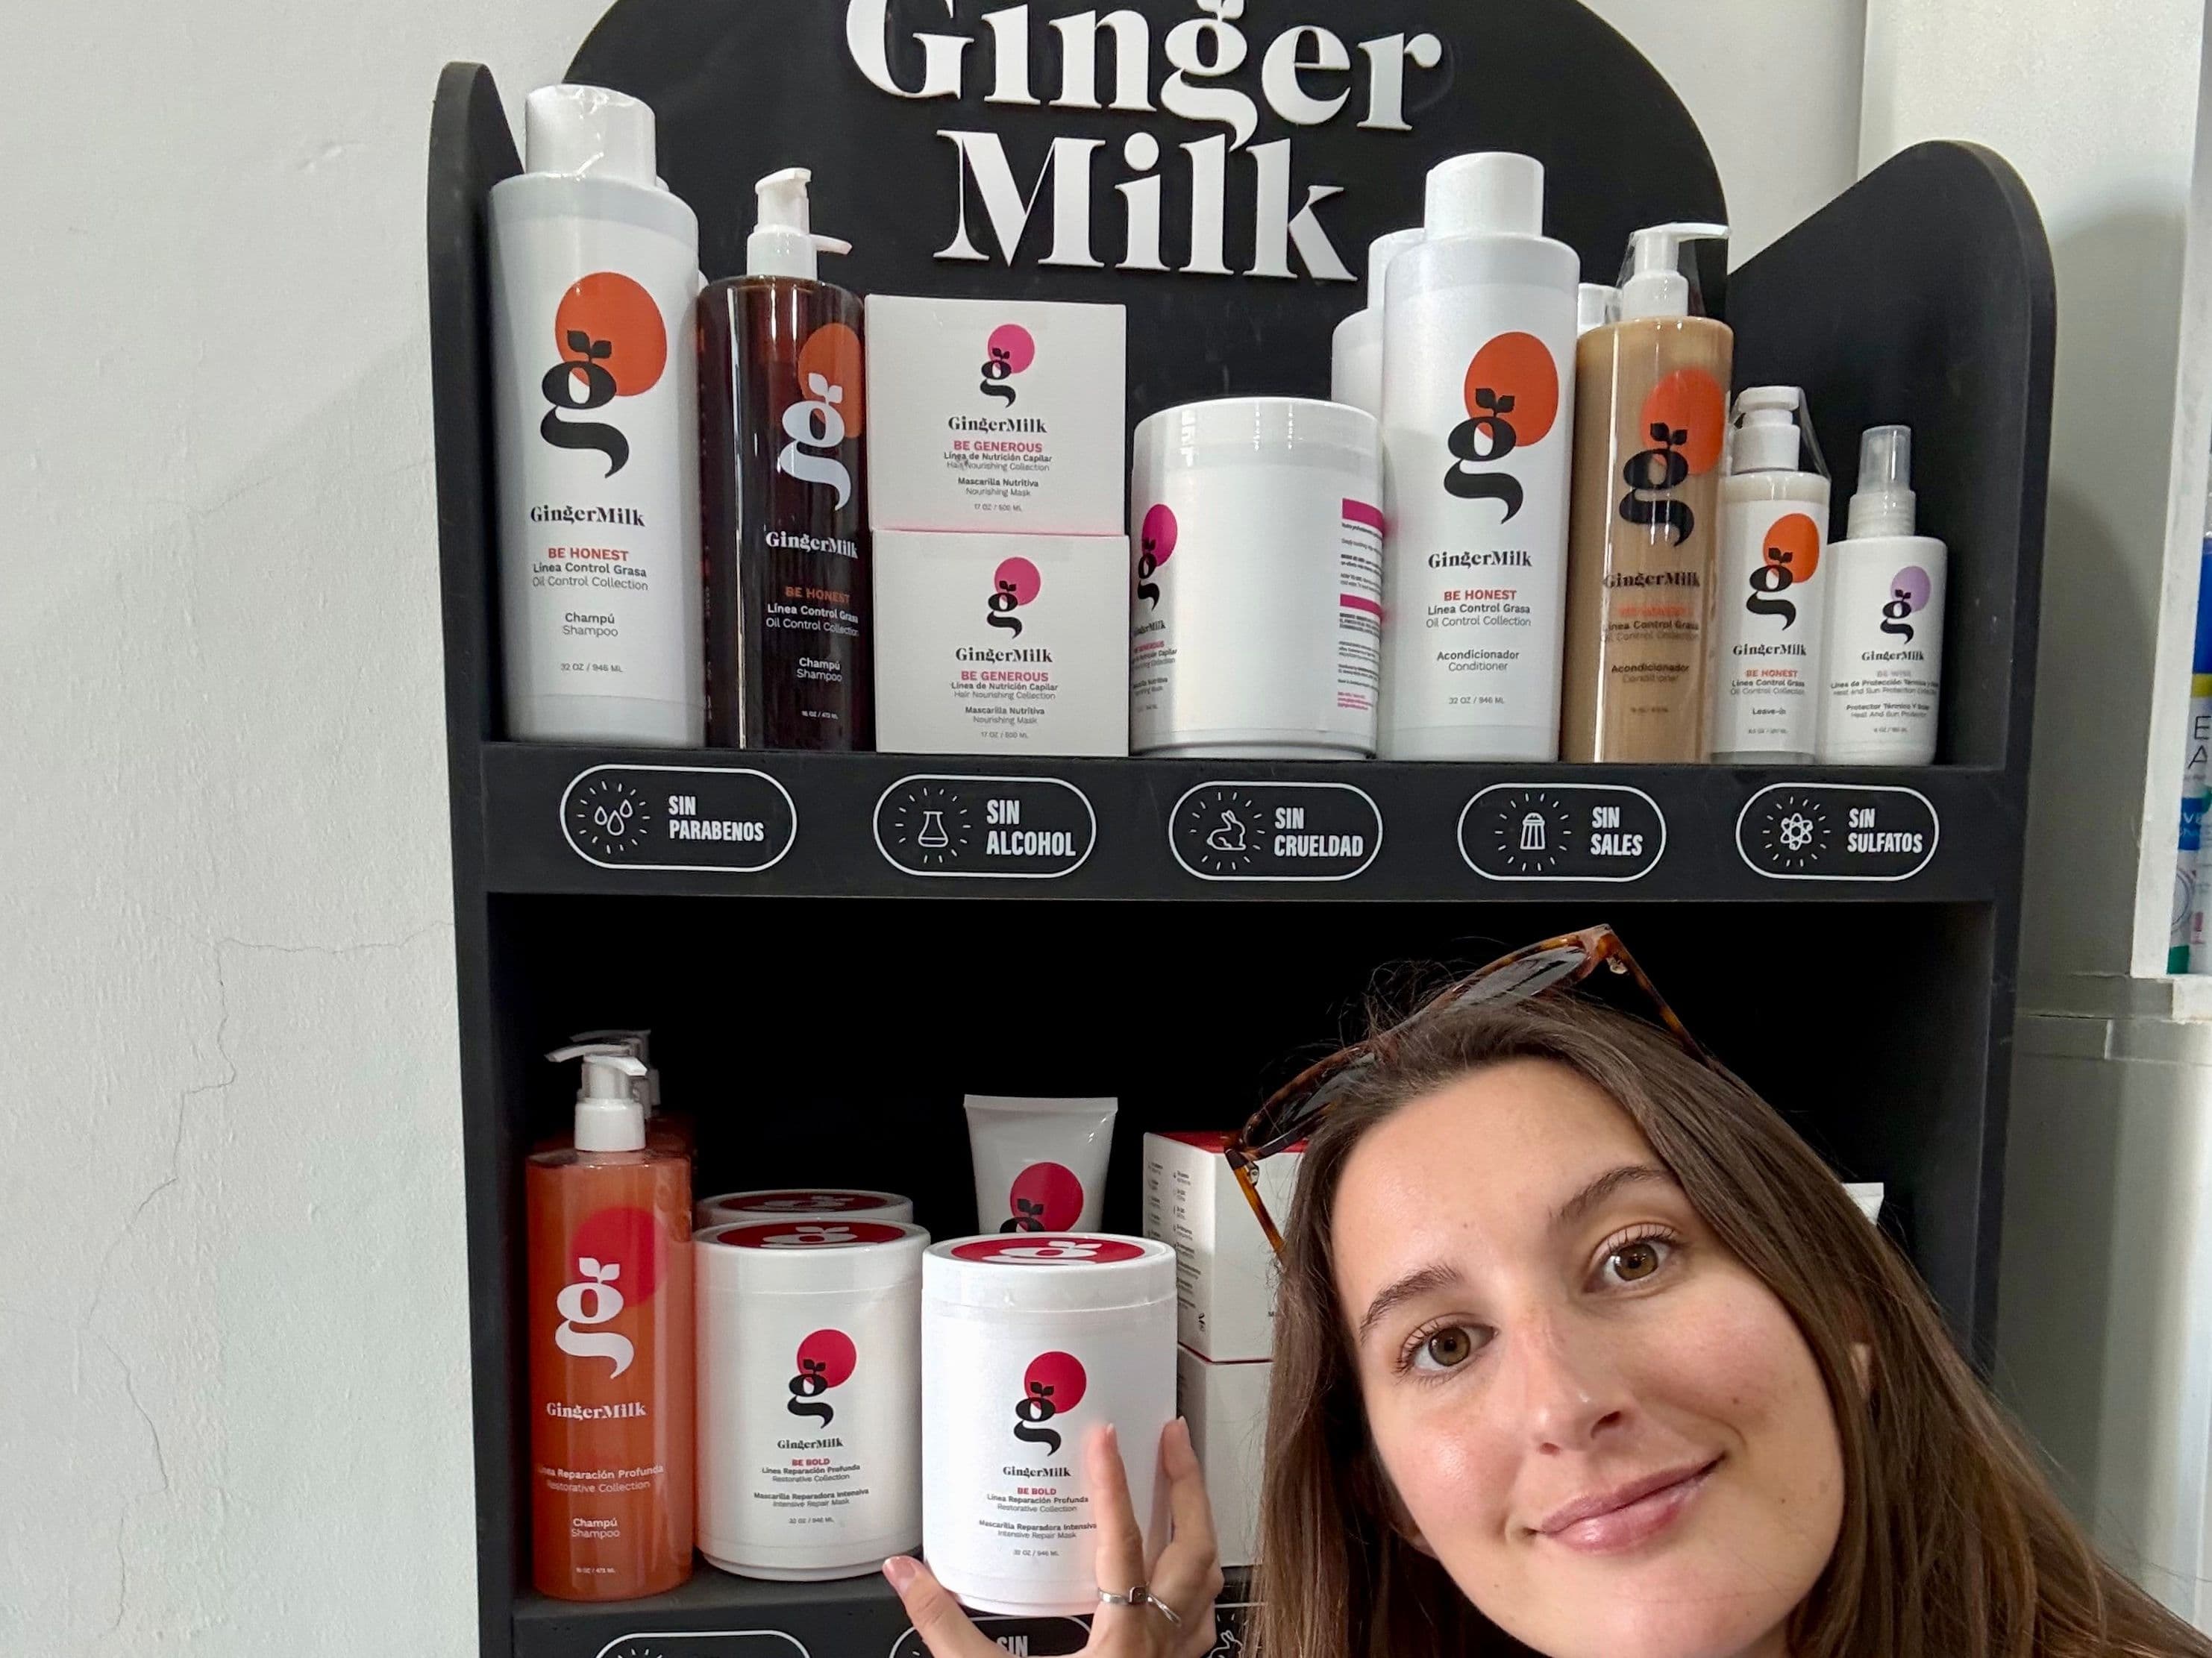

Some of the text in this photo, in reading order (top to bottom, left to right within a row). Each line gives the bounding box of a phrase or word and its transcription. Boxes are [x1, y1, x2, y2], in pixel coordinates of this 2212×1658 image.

[846, 0, 1442, 152] Ginger
[932, 129, 1358, 282] Milk
[948, 415, 1047, 433] GingerMilk
[953, 440, 1043, 453] BE GENEROUS
[982, 453, 1021, 461] Nutrición
[1023, 454, 1053, 462] Capilar
[530, 505, 645, 527] GingerMilk
[765, 531, 858, 559] GingerMilk
[548, 547, 629, 561] BE HONEST
[1428, 550, 1532, 569] GingerMilk
[533, 562, 647, 577] Línea Control Grasa
[533, 576, 648, 590] Oil Control Collection
[785, 586, 850, 603] BE HONEST
[1444, 590, 1517, 601] BE HONEST
[767, 603, 798, 614] Línea
[800, 606, 837, 619] Control
[1428, 603, 1530, 615] Línea Control Grasa
[565, 612, 615, 625] Champú
[766, 618, 780, 627] Oil
[783, 618, 821, 631] Control
[1426, 615, 1531, 628] Oil Control Collection
[563, 625, 618, 637] Shampoo
[956, 647, 1053, 663] GingerMilk
[1437, 650, 1520, 661] Acondicionador
[1733, 644, 1807, 656] GingerMilk
[1861, 650, 1924, 662] GingerMilk
[799, 657, 841, 671] Champú
[1449, 661, 1508, 671] Conditioner
[797, 668, 842, 682] Shampoo
[961, 671, 1049, 682] BE GENEROUS
[989, 682, 1027, 691] Nutrición
[668, 795, 697, 816] SIN
[986, 800, 1020, 825] SIN
[1274, 807, 1305, 829] SIN
[1591, 806, 1620, 829] SIN
[1849, 807, 1876, 829] SIN
[668, 820, 765, 841] PARABENOS
[986, 831, 1077, 857] ALCOHOL
[1273, 835, 1364, 858] CRUELDAD
[1591, 833, 1643, 856] SALES
[1846, 832, 1923, 853] SULFATOS
[546, 1401, 647, 1421] GingerMilk
[777, 1437, 844, 1449] GingerMilk
[618, 1464, 664, 1478] Profunda
[1003, 1466, 1071, 1478] GingerMilk
[598, 1480, 651, 1492] Collection
[1032, 1487, 1056, 1495] BOLD
[573, 1518, 618, 1529] Champú
[571, 1528, 620, 1539] Shampoo
